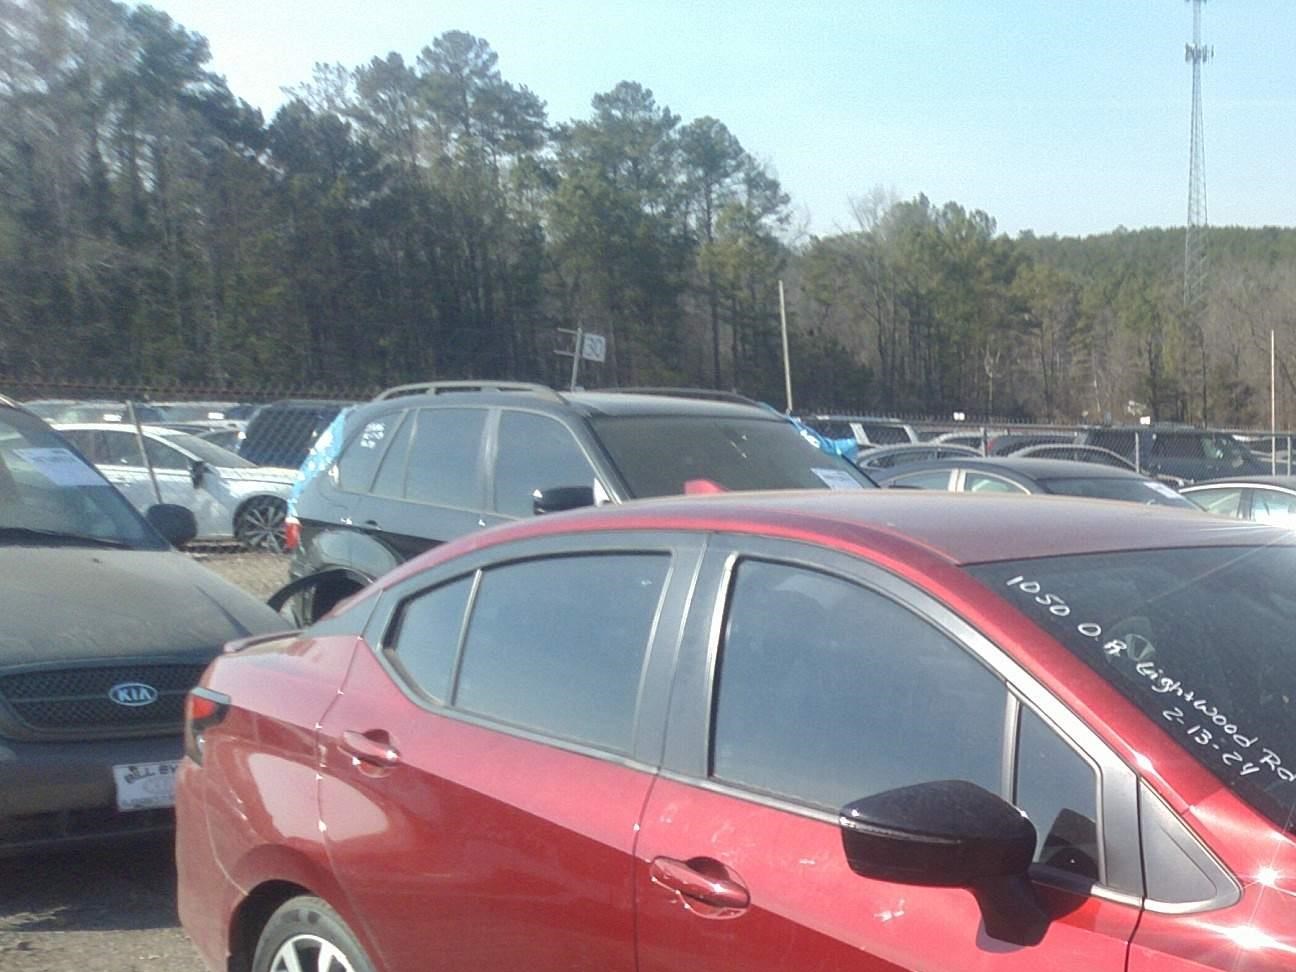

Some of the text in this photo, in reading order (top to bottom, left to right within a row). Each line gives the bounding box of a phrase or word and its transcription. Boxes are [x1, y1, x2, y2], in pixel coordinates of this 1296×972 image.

[1006, 575, 1071, 617] 1050
[117, 688, 152, 702] KIA
[1163, 707, 1260, 776] 2-13-24
